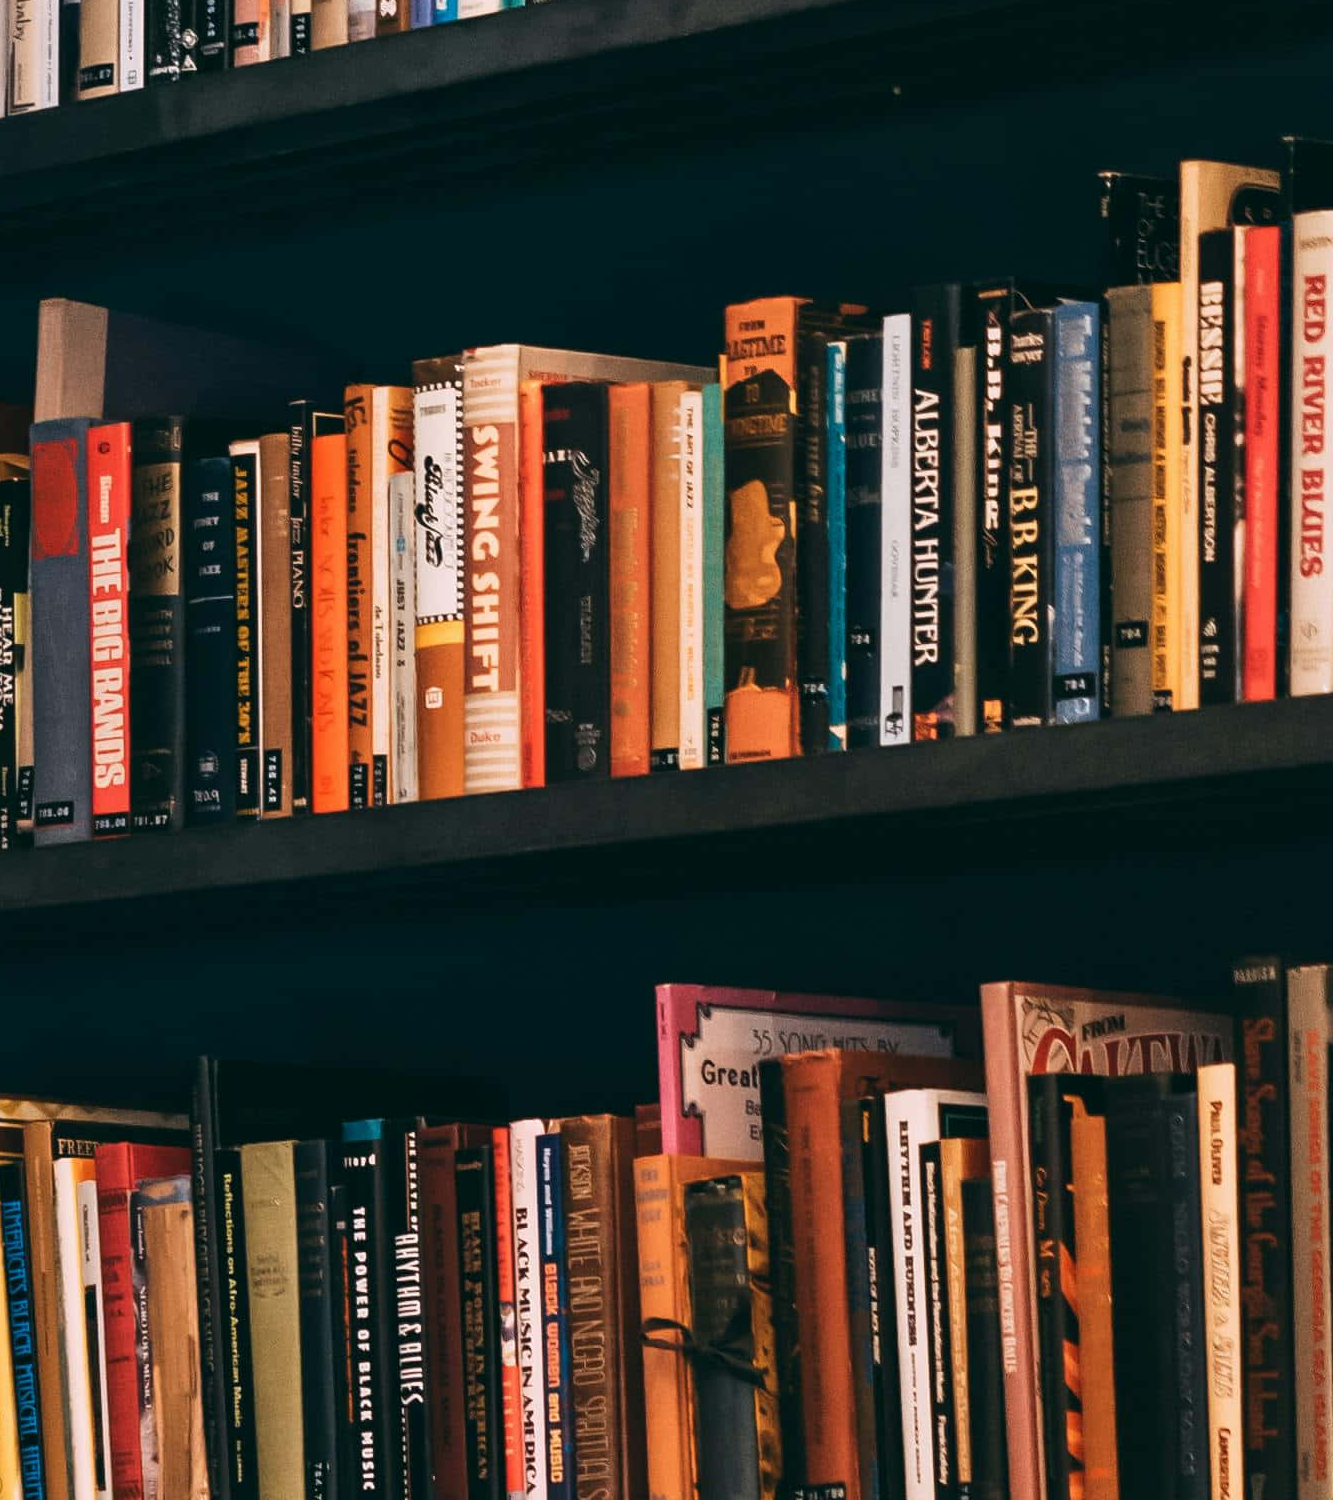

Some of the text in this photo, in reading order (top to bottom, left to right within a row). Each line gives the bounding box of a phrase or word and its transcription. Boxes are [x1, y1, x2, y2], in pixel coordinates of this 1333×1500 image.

[471, 425, 499, 692] SWING SHIFT
[915, 388, 939, 666] ALBERTA HUNTER
[1300, 275, 1325, 578] RED RIVER BLUES
[92, 528, 125, 788] THE BIG BANDS
[514, 1207, 537, 1495] BLACK MUSIC IN AMERICA
